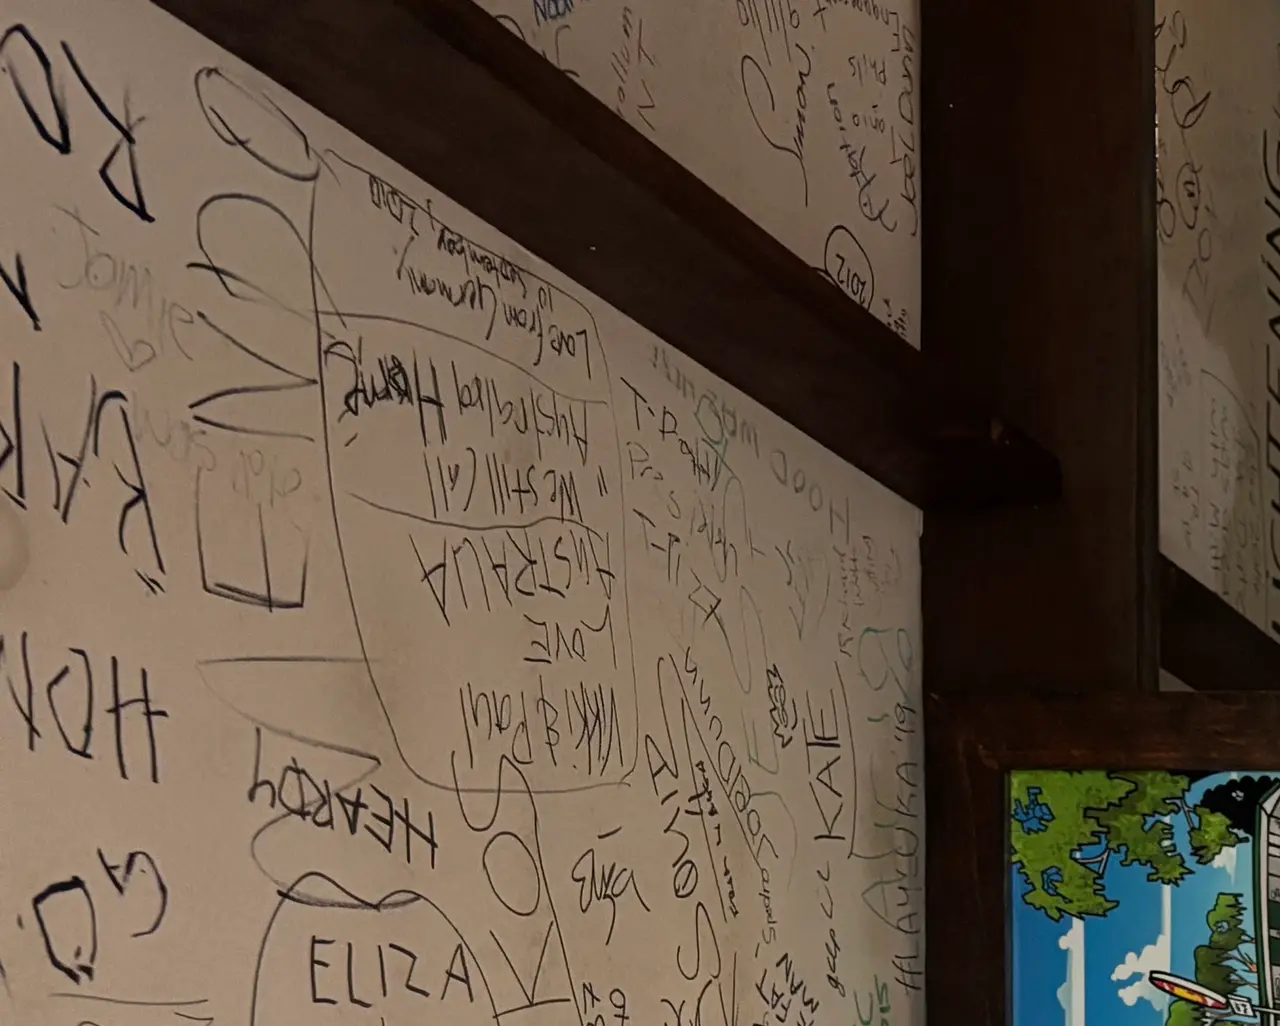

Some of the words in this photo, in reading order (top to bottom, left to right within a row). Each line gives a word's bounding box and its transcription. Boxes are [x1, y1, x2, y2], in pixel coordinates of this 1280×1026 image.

[803, 688, 846, 841] KATE
[309, 935, 477, 1008] ELIZA
[755, 968, 792, 1022] FAT
[775, 952, 820, 1014] MAN
